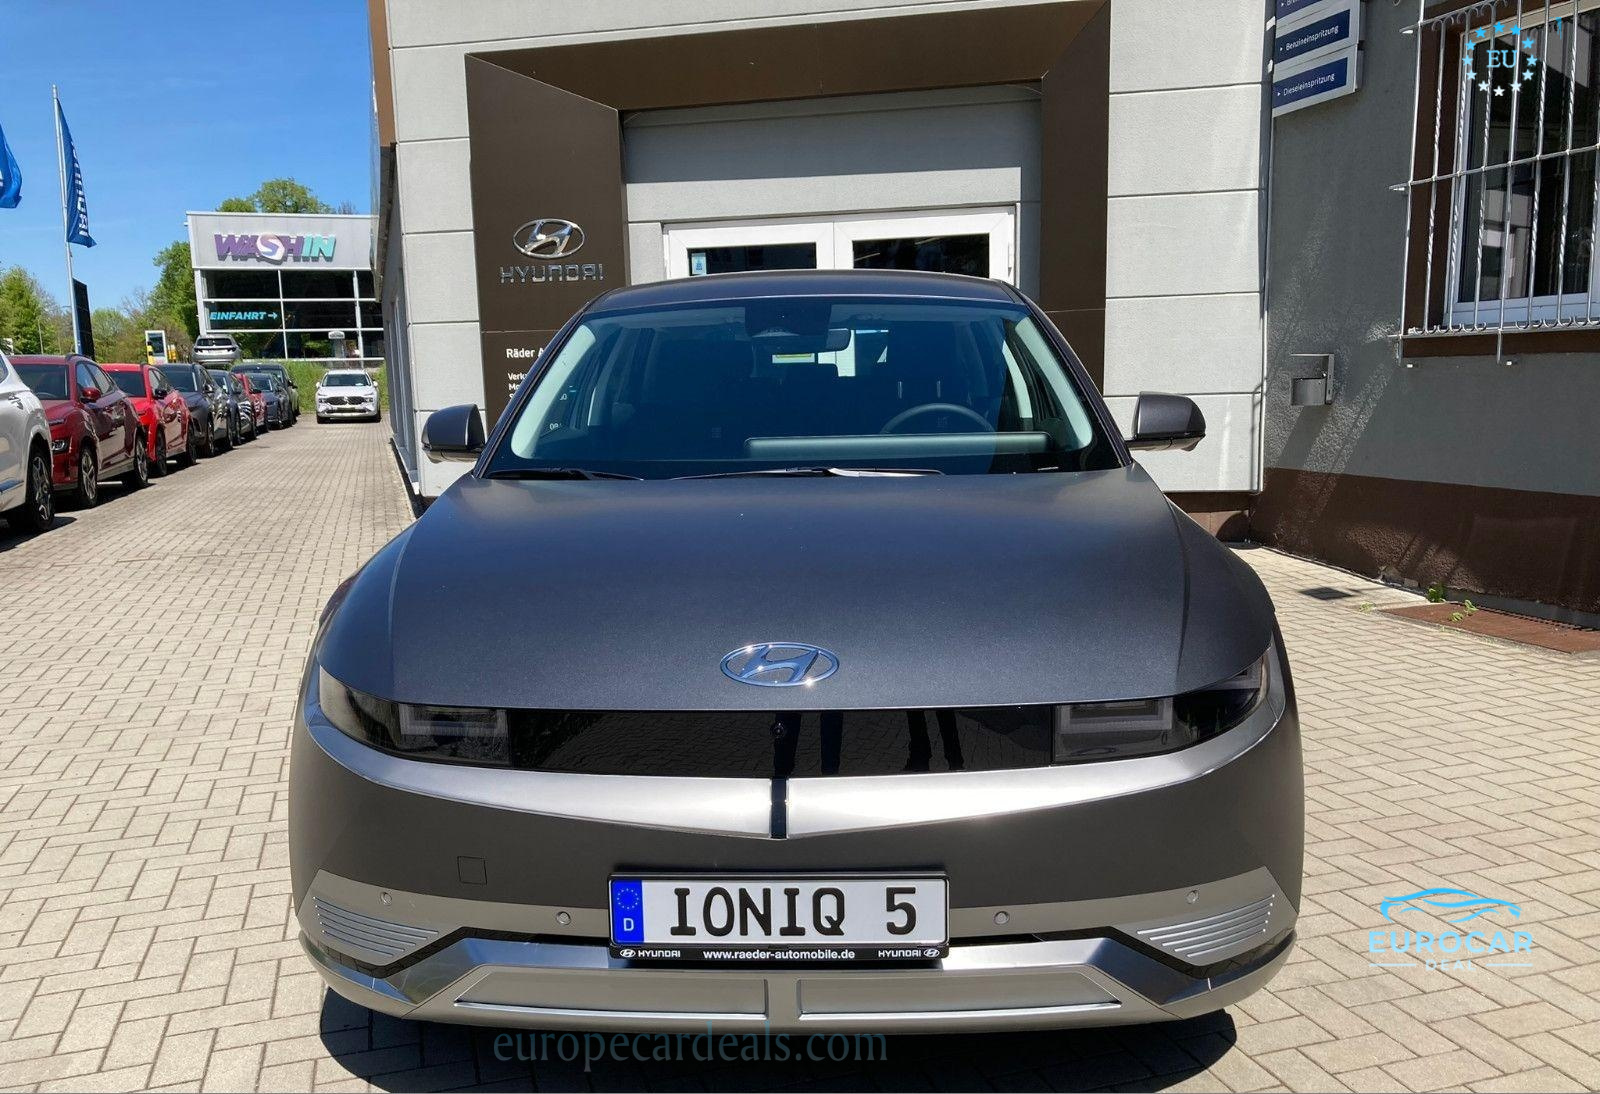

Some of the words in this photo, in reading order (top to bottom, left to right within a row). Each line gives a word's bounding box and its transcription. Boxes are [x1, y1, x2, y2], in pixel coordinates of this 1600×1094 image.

[1285, 25, 1339, 51] Benzineinspritzung
[1283, 73, 1335, 97] Dieseleinspritzung
[500, 263, 604, 284] HYUNDAI
[209, 311, 267, 321] EINFAHRT
[506, 347, 536, 359] Räder
[623, 917, 635, 931] D
[670, 886, 845, 937] IONIQ
[886, 886, 917, 936] 5
[637, 949, 681, 958] HYUNDAI
[702, 949, 856, 960] www.raeder-automobile.de
[878, 949, 922, 958] HYUNDAI
